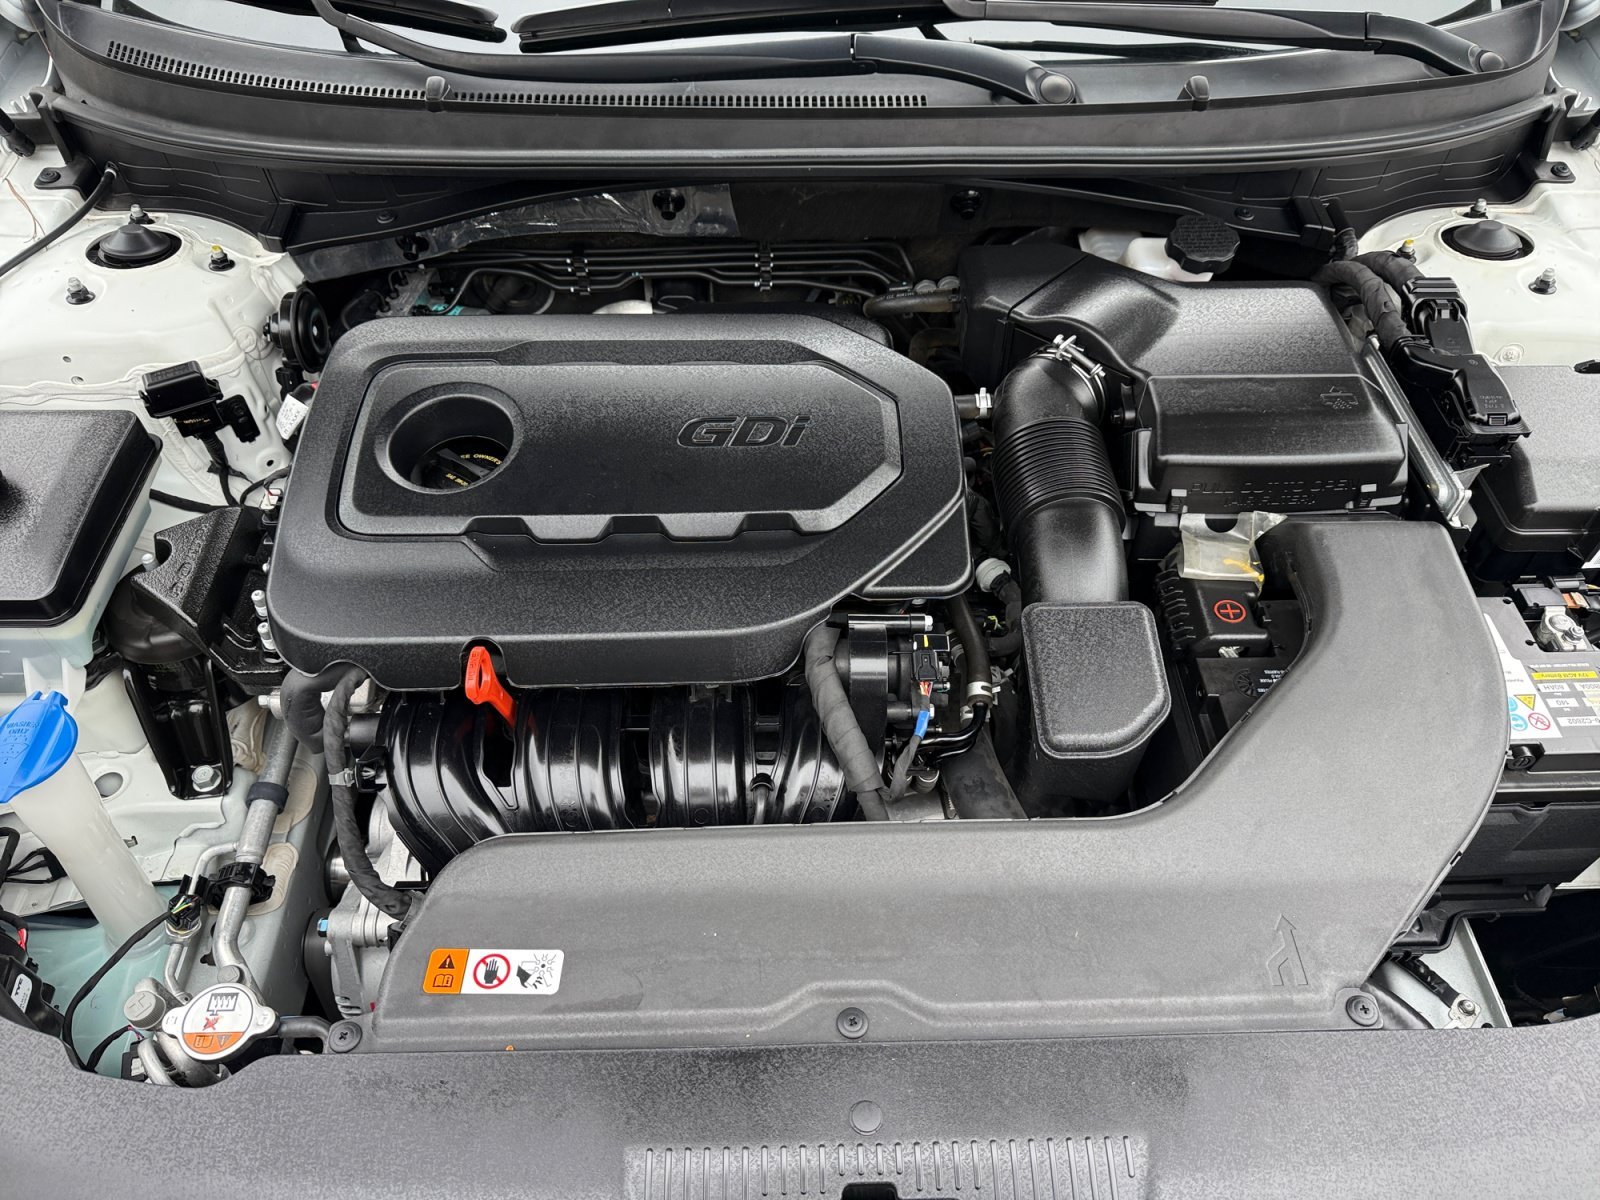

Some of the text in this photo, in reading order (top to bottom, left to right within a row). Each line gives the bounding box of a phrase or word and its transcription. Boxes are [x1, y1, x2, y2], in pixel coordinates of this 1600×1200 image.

[676, 414, 811, 448] GDi
[1188, 479, 1361, 495] PULL OUT TO OPEN
